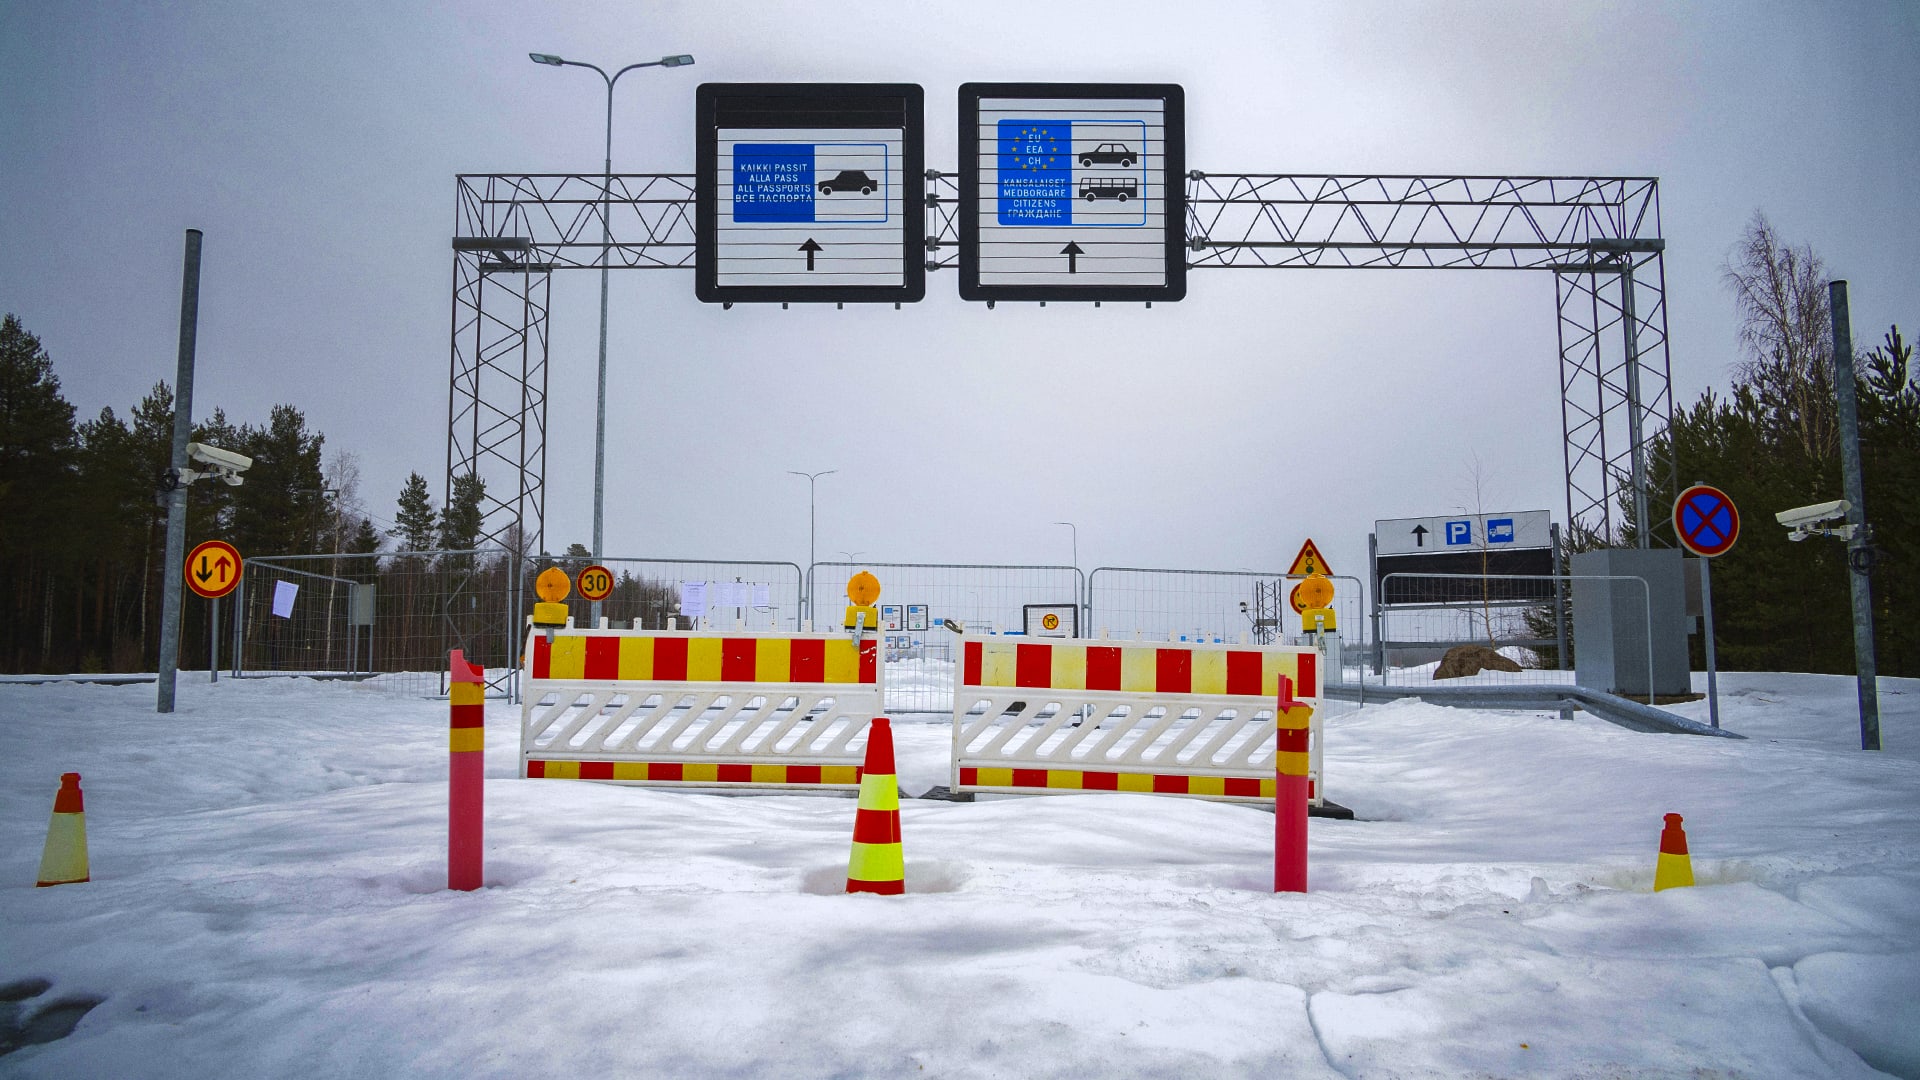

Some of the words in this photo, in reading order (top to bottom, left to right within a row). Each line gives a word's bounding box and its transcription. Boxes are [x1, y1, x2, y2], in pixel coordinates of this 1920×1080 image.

[1028, 134, 1041, 143] EU
[1026, 145, 1043, 154] EEA
[1028, 156, 1041, 165] CH
[740, 163, 772, 172] KAIKKI
[774, 163, 808, 172] PASSIT
[749, 174, 771, 182] ALLA
[774, 174, 799, 182] PASS
[1003, 178, 1066, 188] KANSALAISET
[737, 184, 754, 193] ALL
[757, 184, 811, 193] PASSPORTS
[1003, 189, 1066, 197] MEDBORGARE
[735, 194, 756, 203] ВСЕ
[758, 194, 813, 203] ПАСПОРТА
[1013, 199, 1057, 208] CITIZENS
[1007, 209, 1062, 219] ГРАЖДАНЕ
[1450, 523, 1467, 544] P
[584, 574, 607, 592] 30
